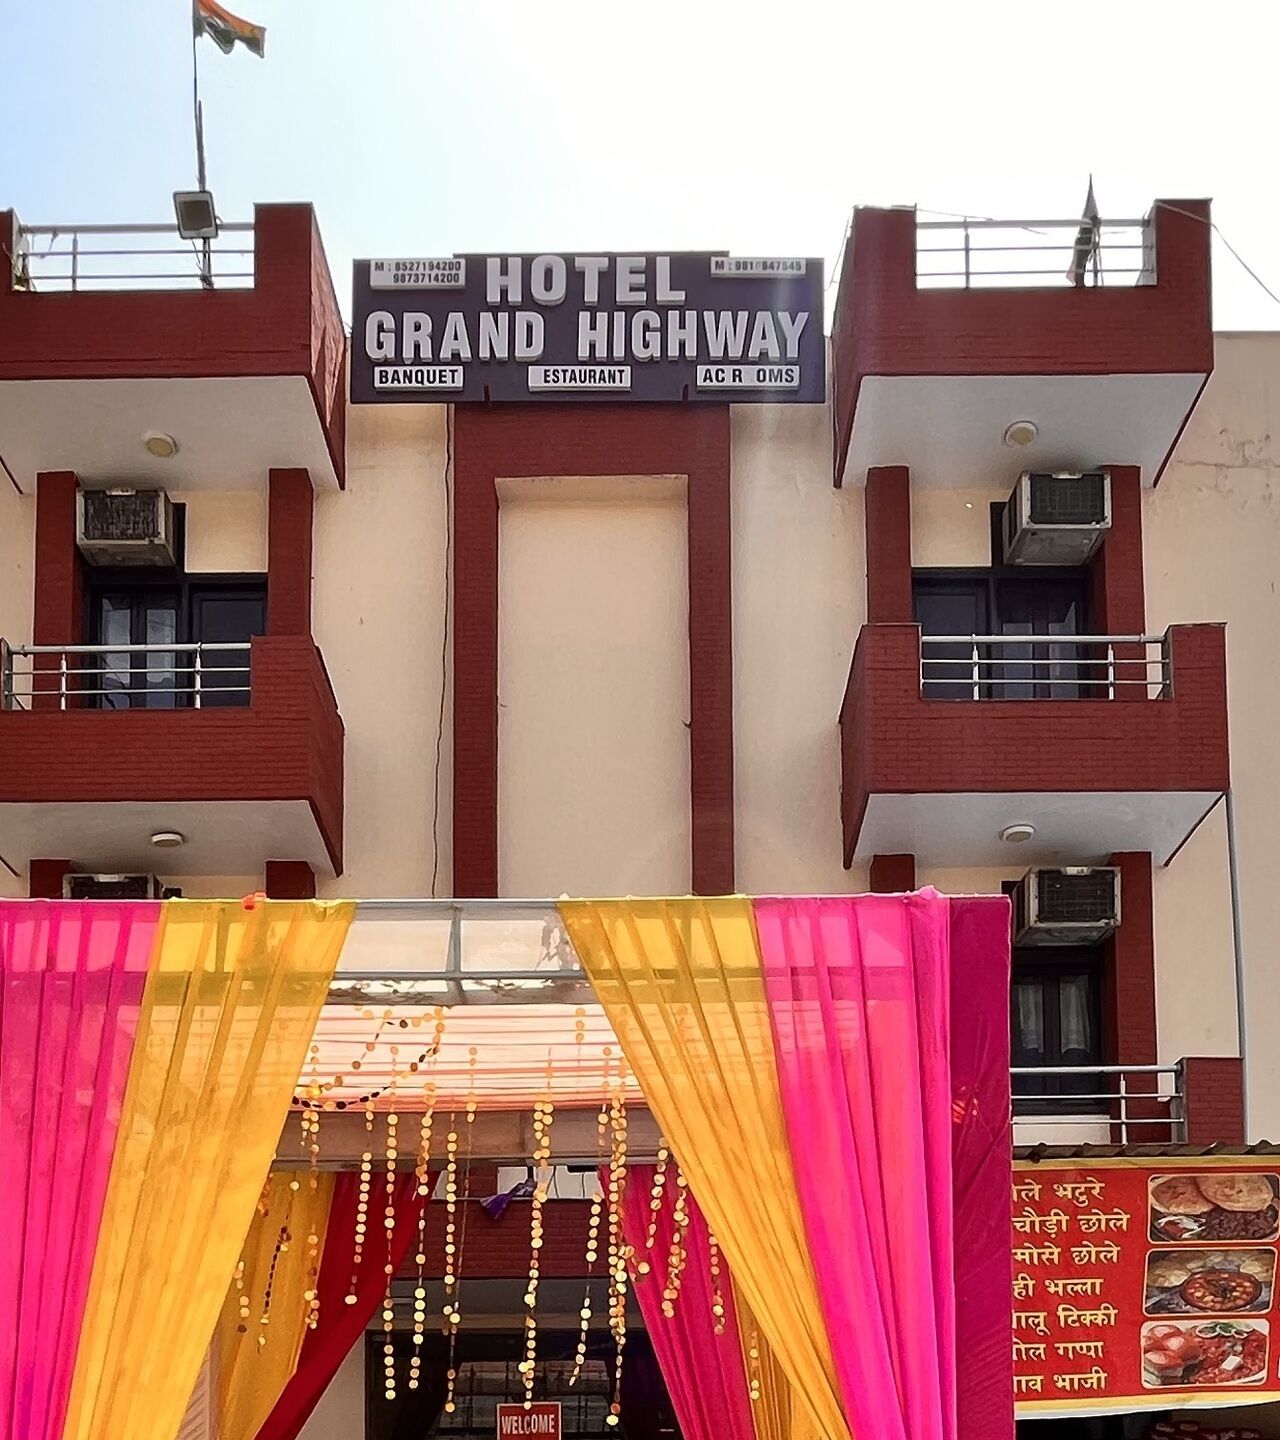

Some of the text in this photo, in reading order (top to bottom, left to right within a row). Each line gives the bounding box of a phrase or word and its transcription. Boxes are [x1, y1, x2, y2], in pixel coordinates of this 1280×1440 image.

[484, 255, 686, 305] HOTEL
[365, 310, 810, 363] GRAND HIGHWAY
[378, 370, 459, 387] BANQUET
[1077, 1208, 1131, 1233] छोले
[1070, 1240, 1121, 1265] छोले
[1044, 1278, 1104, 1297] भल्ला
[1056, 1303, 1118, 1328] टिक्की
[1053, 1341, 1104, 1360] गप्पा
[1052, 1366, 1108, 1392] भाजी
[501, 1413, 555, 1435] WELCOME
